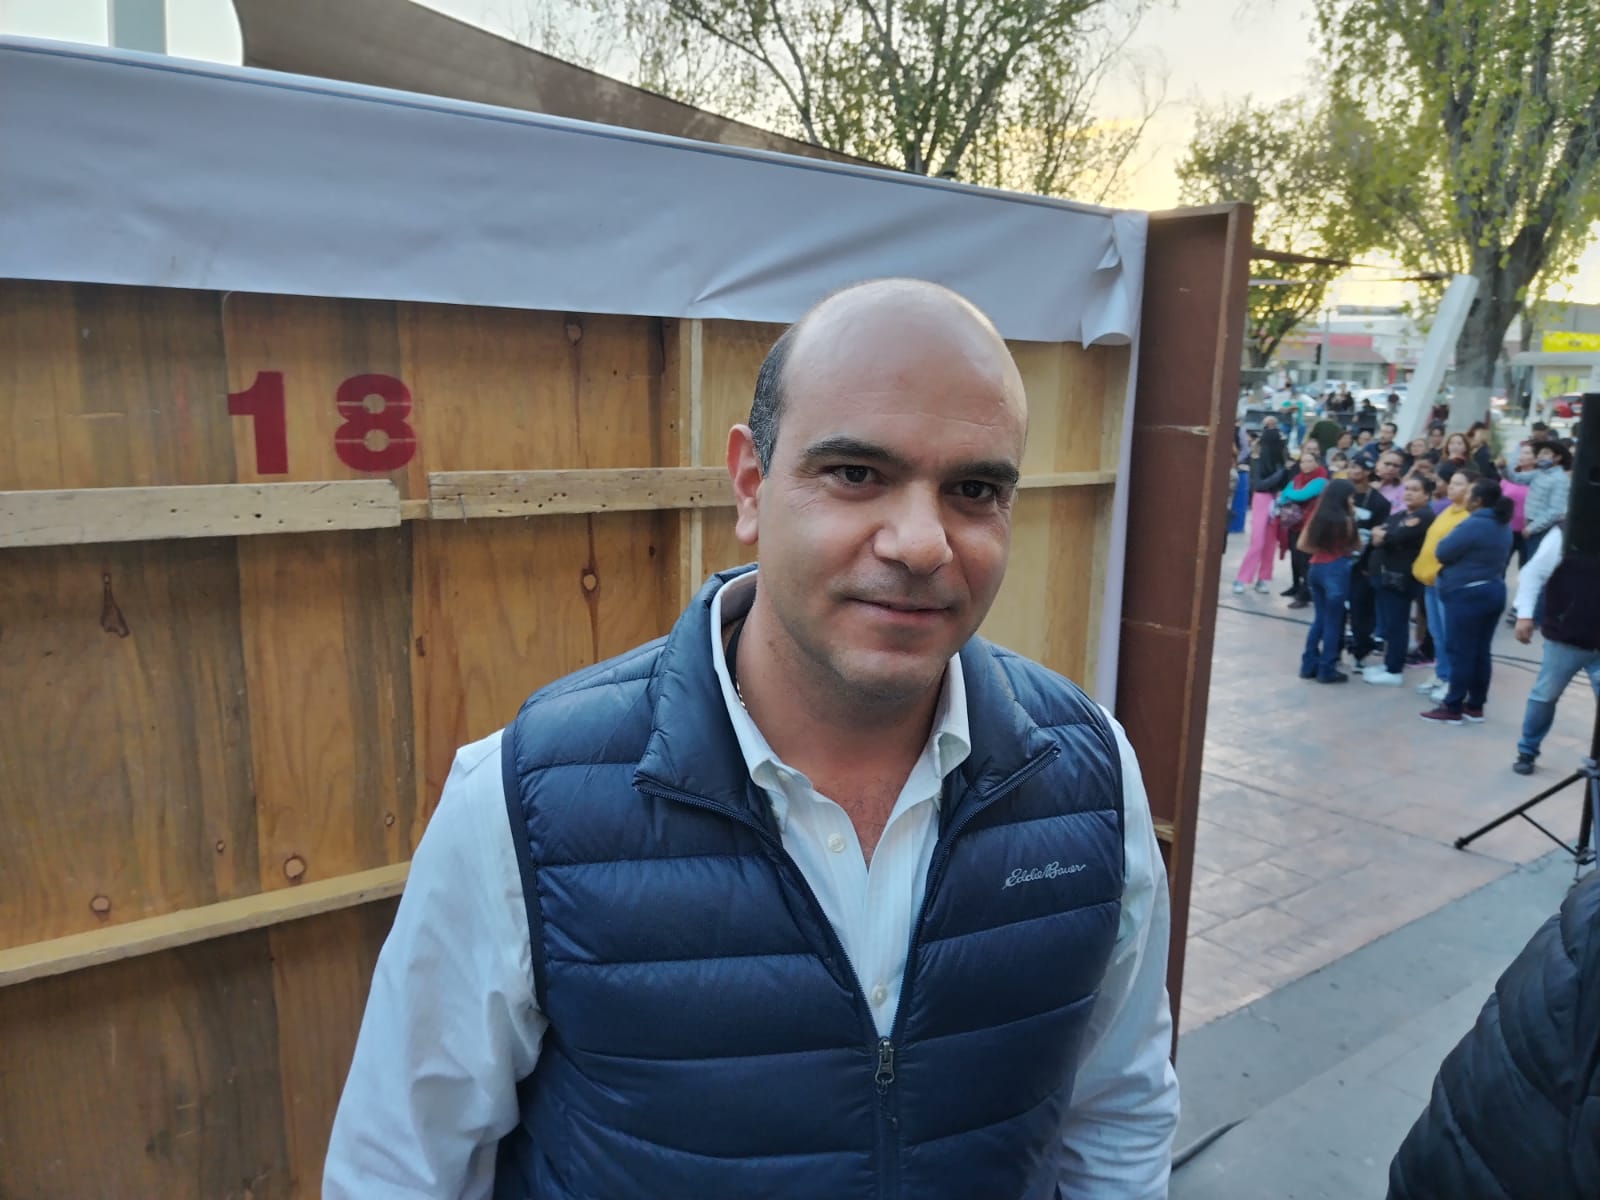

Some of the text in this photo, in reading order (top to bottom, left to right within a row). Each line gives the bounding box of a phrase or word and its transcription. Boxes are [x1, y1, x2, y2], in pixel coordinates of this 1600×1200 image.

[227, 371, 416, 474] 18
[1002, 861, 1087, 890] Eddie Bauer
